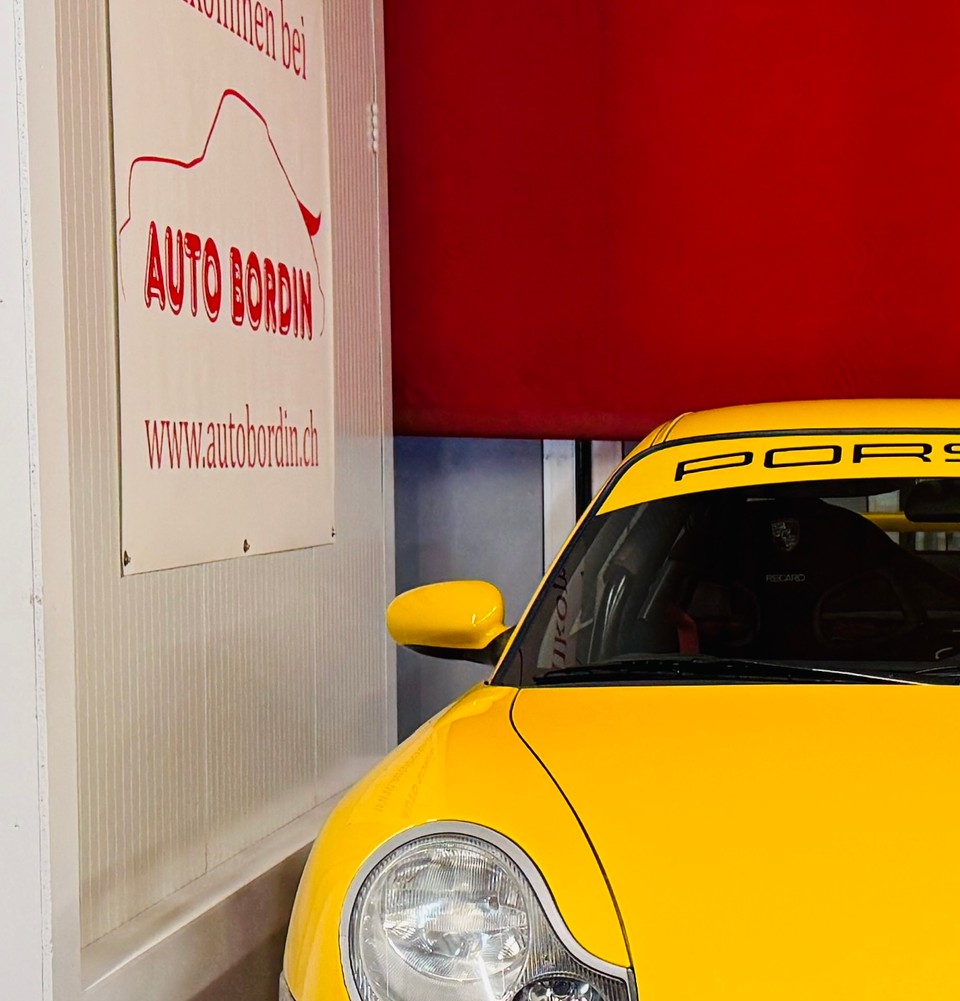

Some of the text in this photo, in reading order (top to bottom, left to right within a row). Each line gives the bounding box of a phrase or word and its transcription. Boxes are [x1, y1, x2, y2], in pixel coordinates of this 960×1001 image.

[280, 0, 307, 81] bei
[144, 220, 313, 341] AUTO BORDIN
[144, 403, 319, 469] www.autobordin.ch
[765, 573, 806, 582] RECARO
